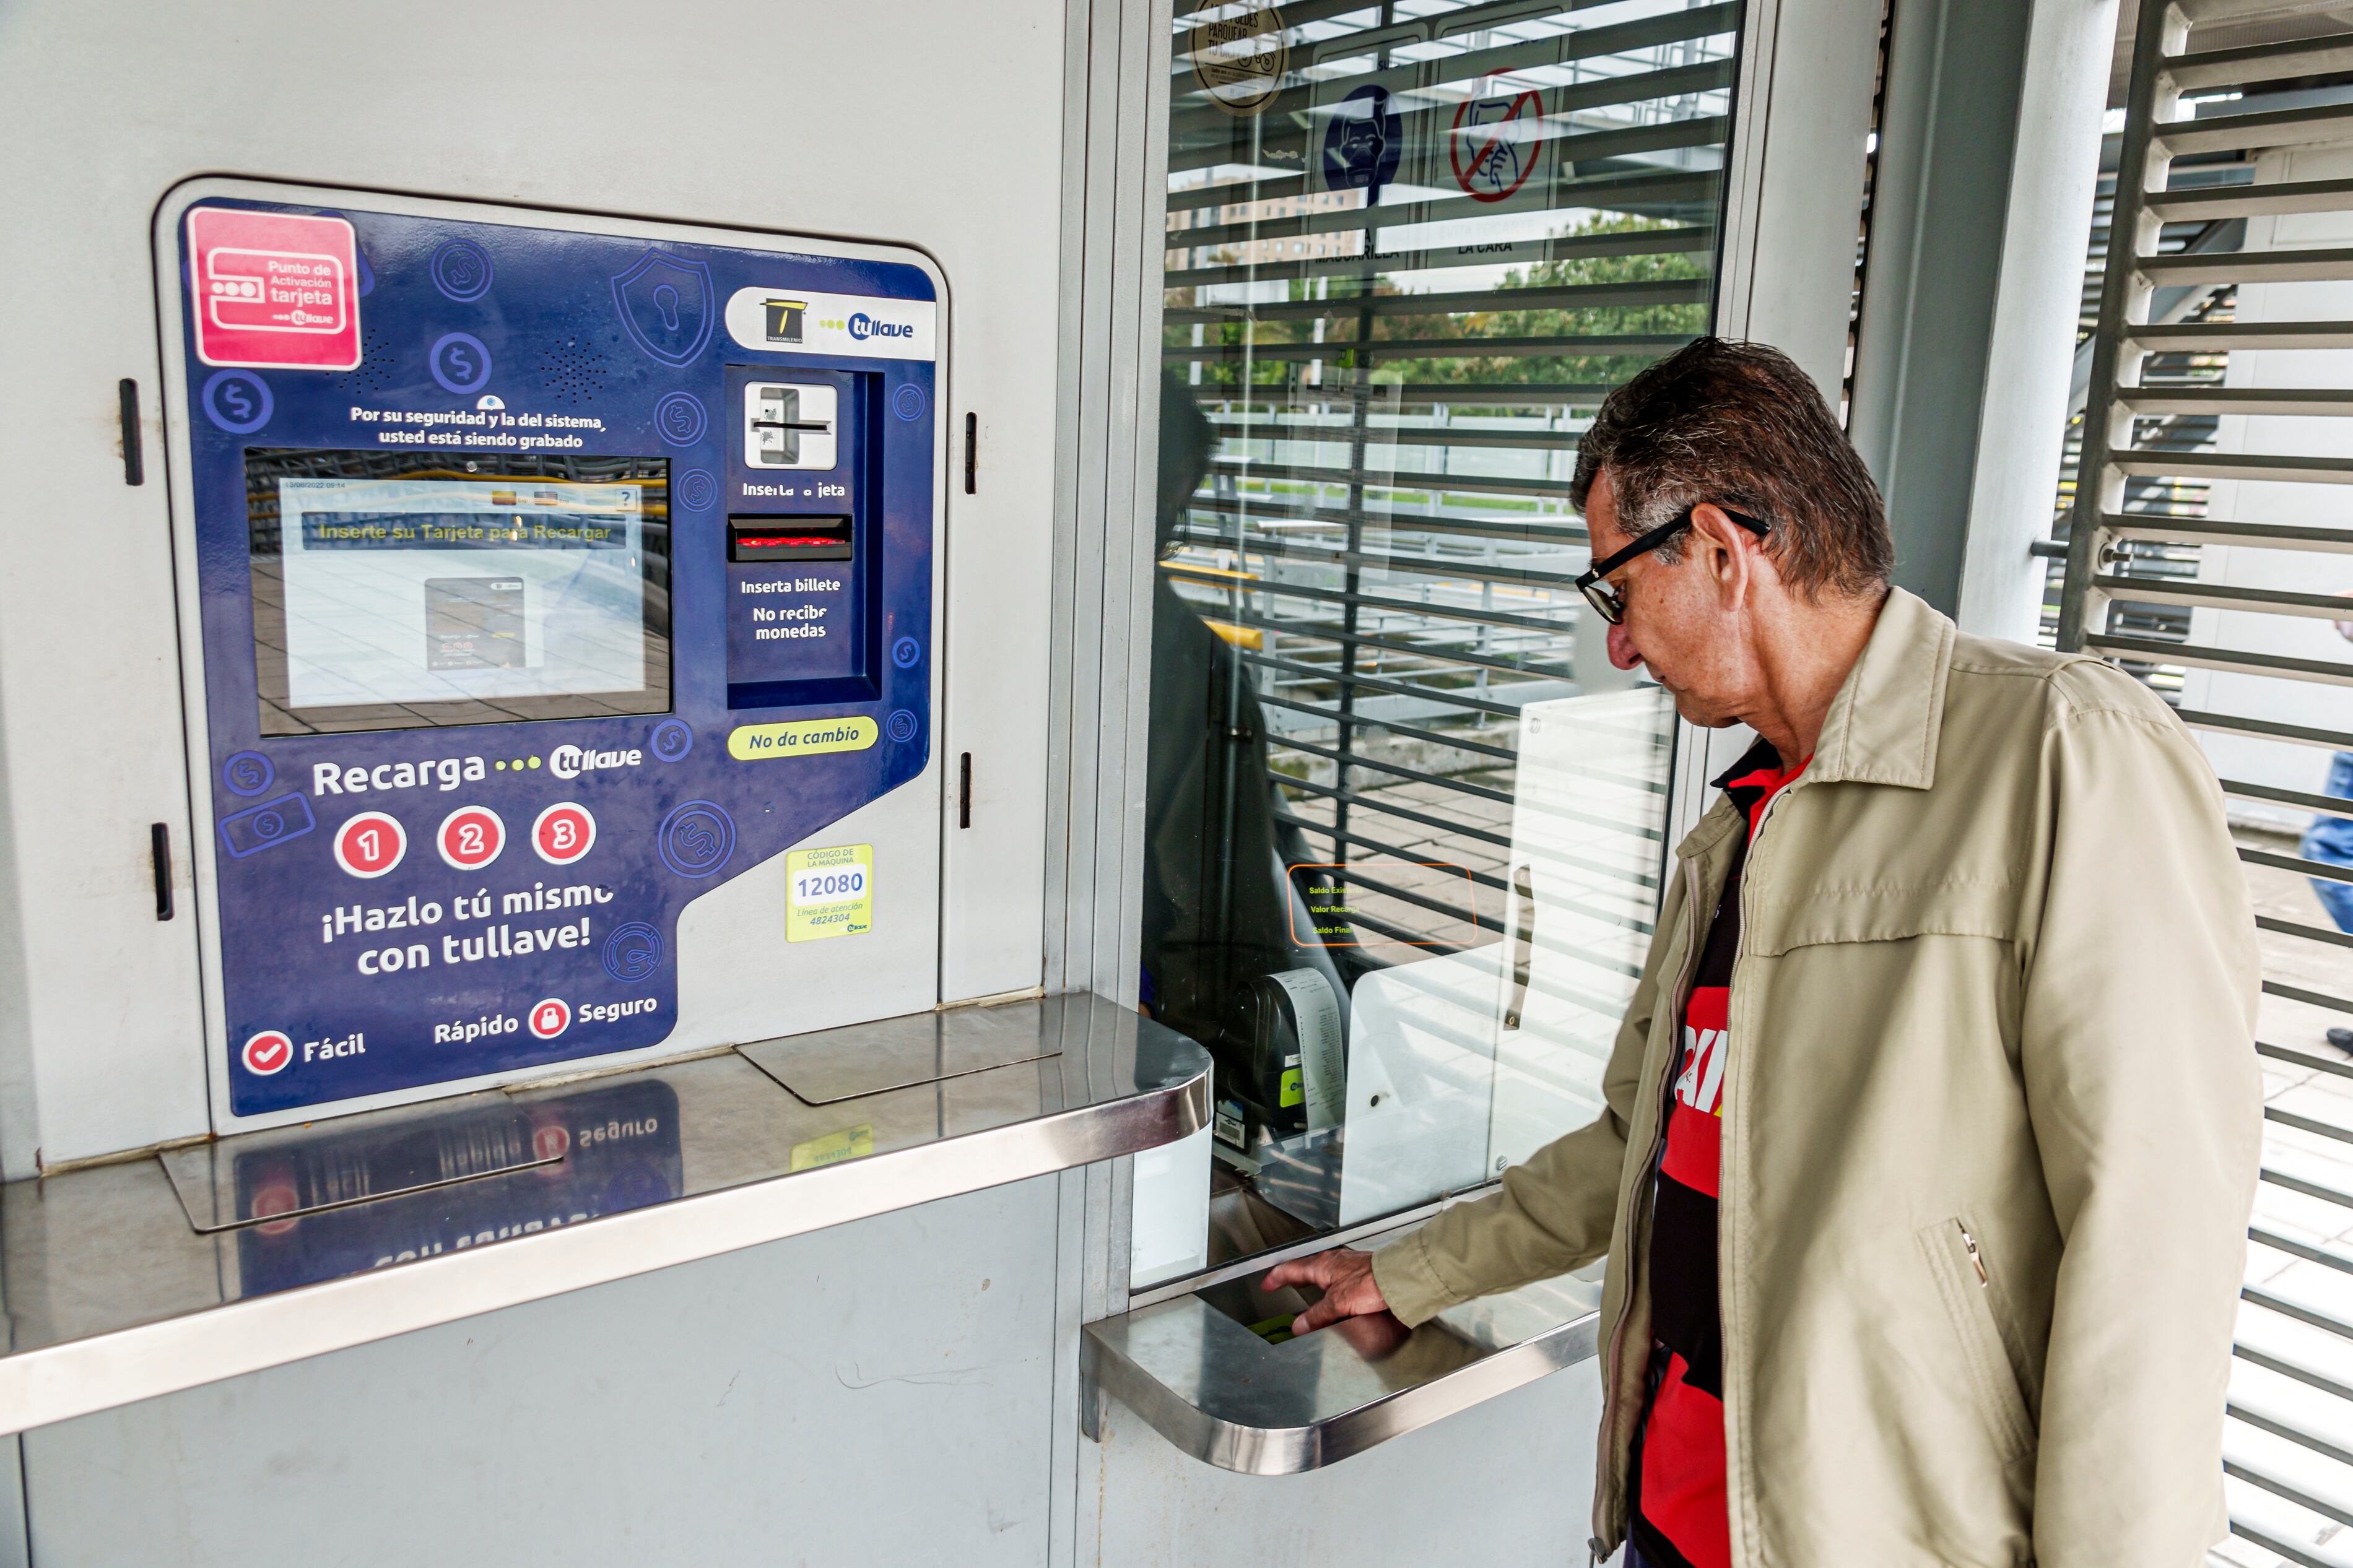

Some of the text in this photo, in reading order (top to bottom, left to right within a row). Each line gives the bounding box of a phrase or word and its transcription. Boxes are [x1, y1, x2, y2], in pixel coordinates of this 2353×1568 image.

[1209, 22, 1247, 40] PARQUEAR
[268, 261, 331, 275] Punto de
[271, 275, 332, 288] Activación
[271, 287, 333, 308] tarjeta
[848, 313, 913, 340] tullave
[351, 407, 606, 432] Por su seguridad y la del sistema,
[379, 430, 583, 450] usted está siendo grabado
[320, 524, 611, 542] Inserte su Tarjeta para Recargar
[741, 578, 841, 594] Inserta billete
[753, 608, 776, 621] No
[756, 623, 826, 640] monedas
[749, 726, 859, 749] No da cambio
[313, 744, 642, 796] Recarga tullave
[357, 819, 576, 861] 1 2 3
[807, 849, 840, 859] CÓDIGO
[819, 857, 854, 866] MÁQUINA
[798, 873, 863, 897] 12080
[322, 881, 614, 943] ¡Hazlo tú mismo
[797, 908, 817, 916] Línea
[831, 902, 863, 913] atención
[1331, 906, 1360, 914] Recarga
[810, 913, 850, 925] 4824304
[357, 917, 590, 976] con tullave!
[435, 998, 658, 1044] Rápido Seguro
[304, 1033, 366, 1062] Fácil
